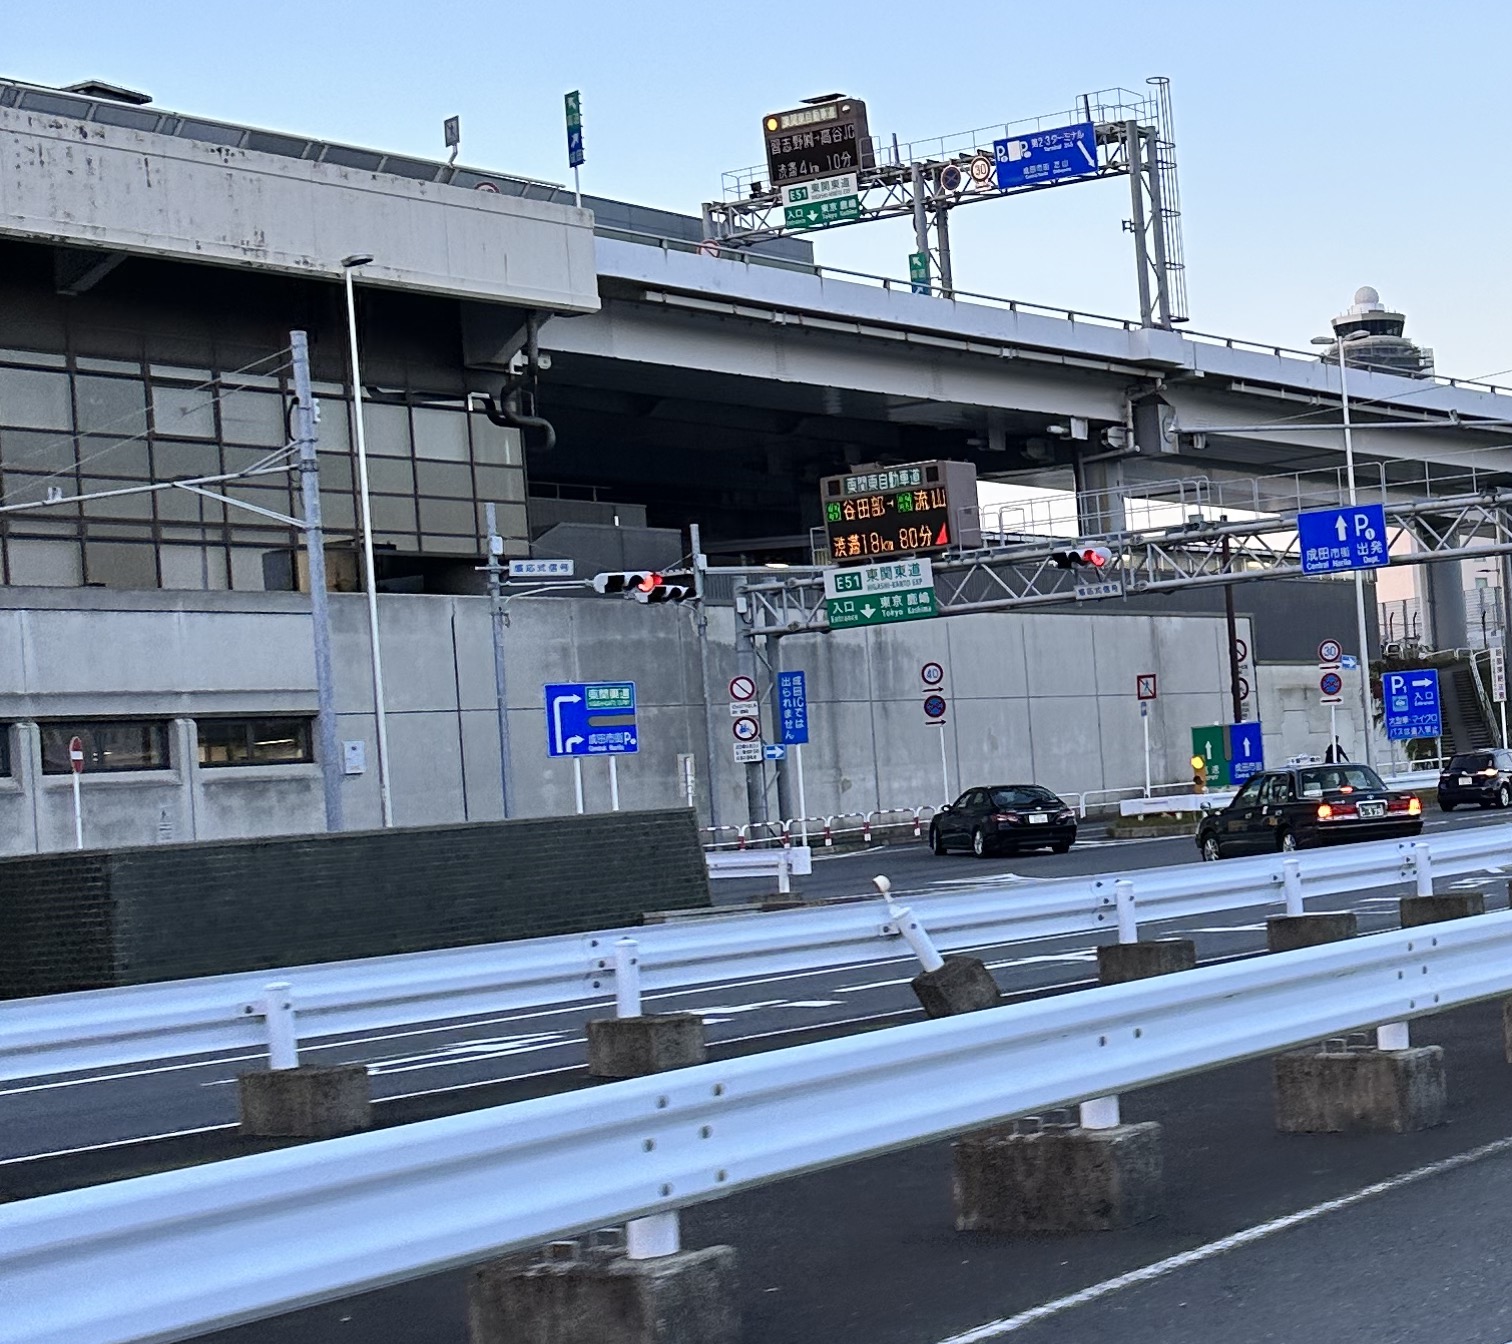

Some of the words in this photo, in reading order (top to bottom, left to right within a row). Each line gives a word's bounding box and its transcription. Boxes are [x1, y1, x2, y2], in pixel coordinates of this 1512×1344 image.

[789, 188, 807, 201] E51
[845, 467, 921, 494] 東関東自動車道
[913, 488, 947, 511] 流山
[899, 524, 933, 549] 80分
[1357, 540, 1383, 556] 出発
[865, 562, 922, 583] 東関東道
[836, 575, 861, 590] E51
[832, 600, 855, 615] 入口
[879, 594, 904, 609] 東京
[1323, 645, 1337, 657] 30
[926, 668, 939, 679] 40
[781, 676, 795, 740] 出られません
